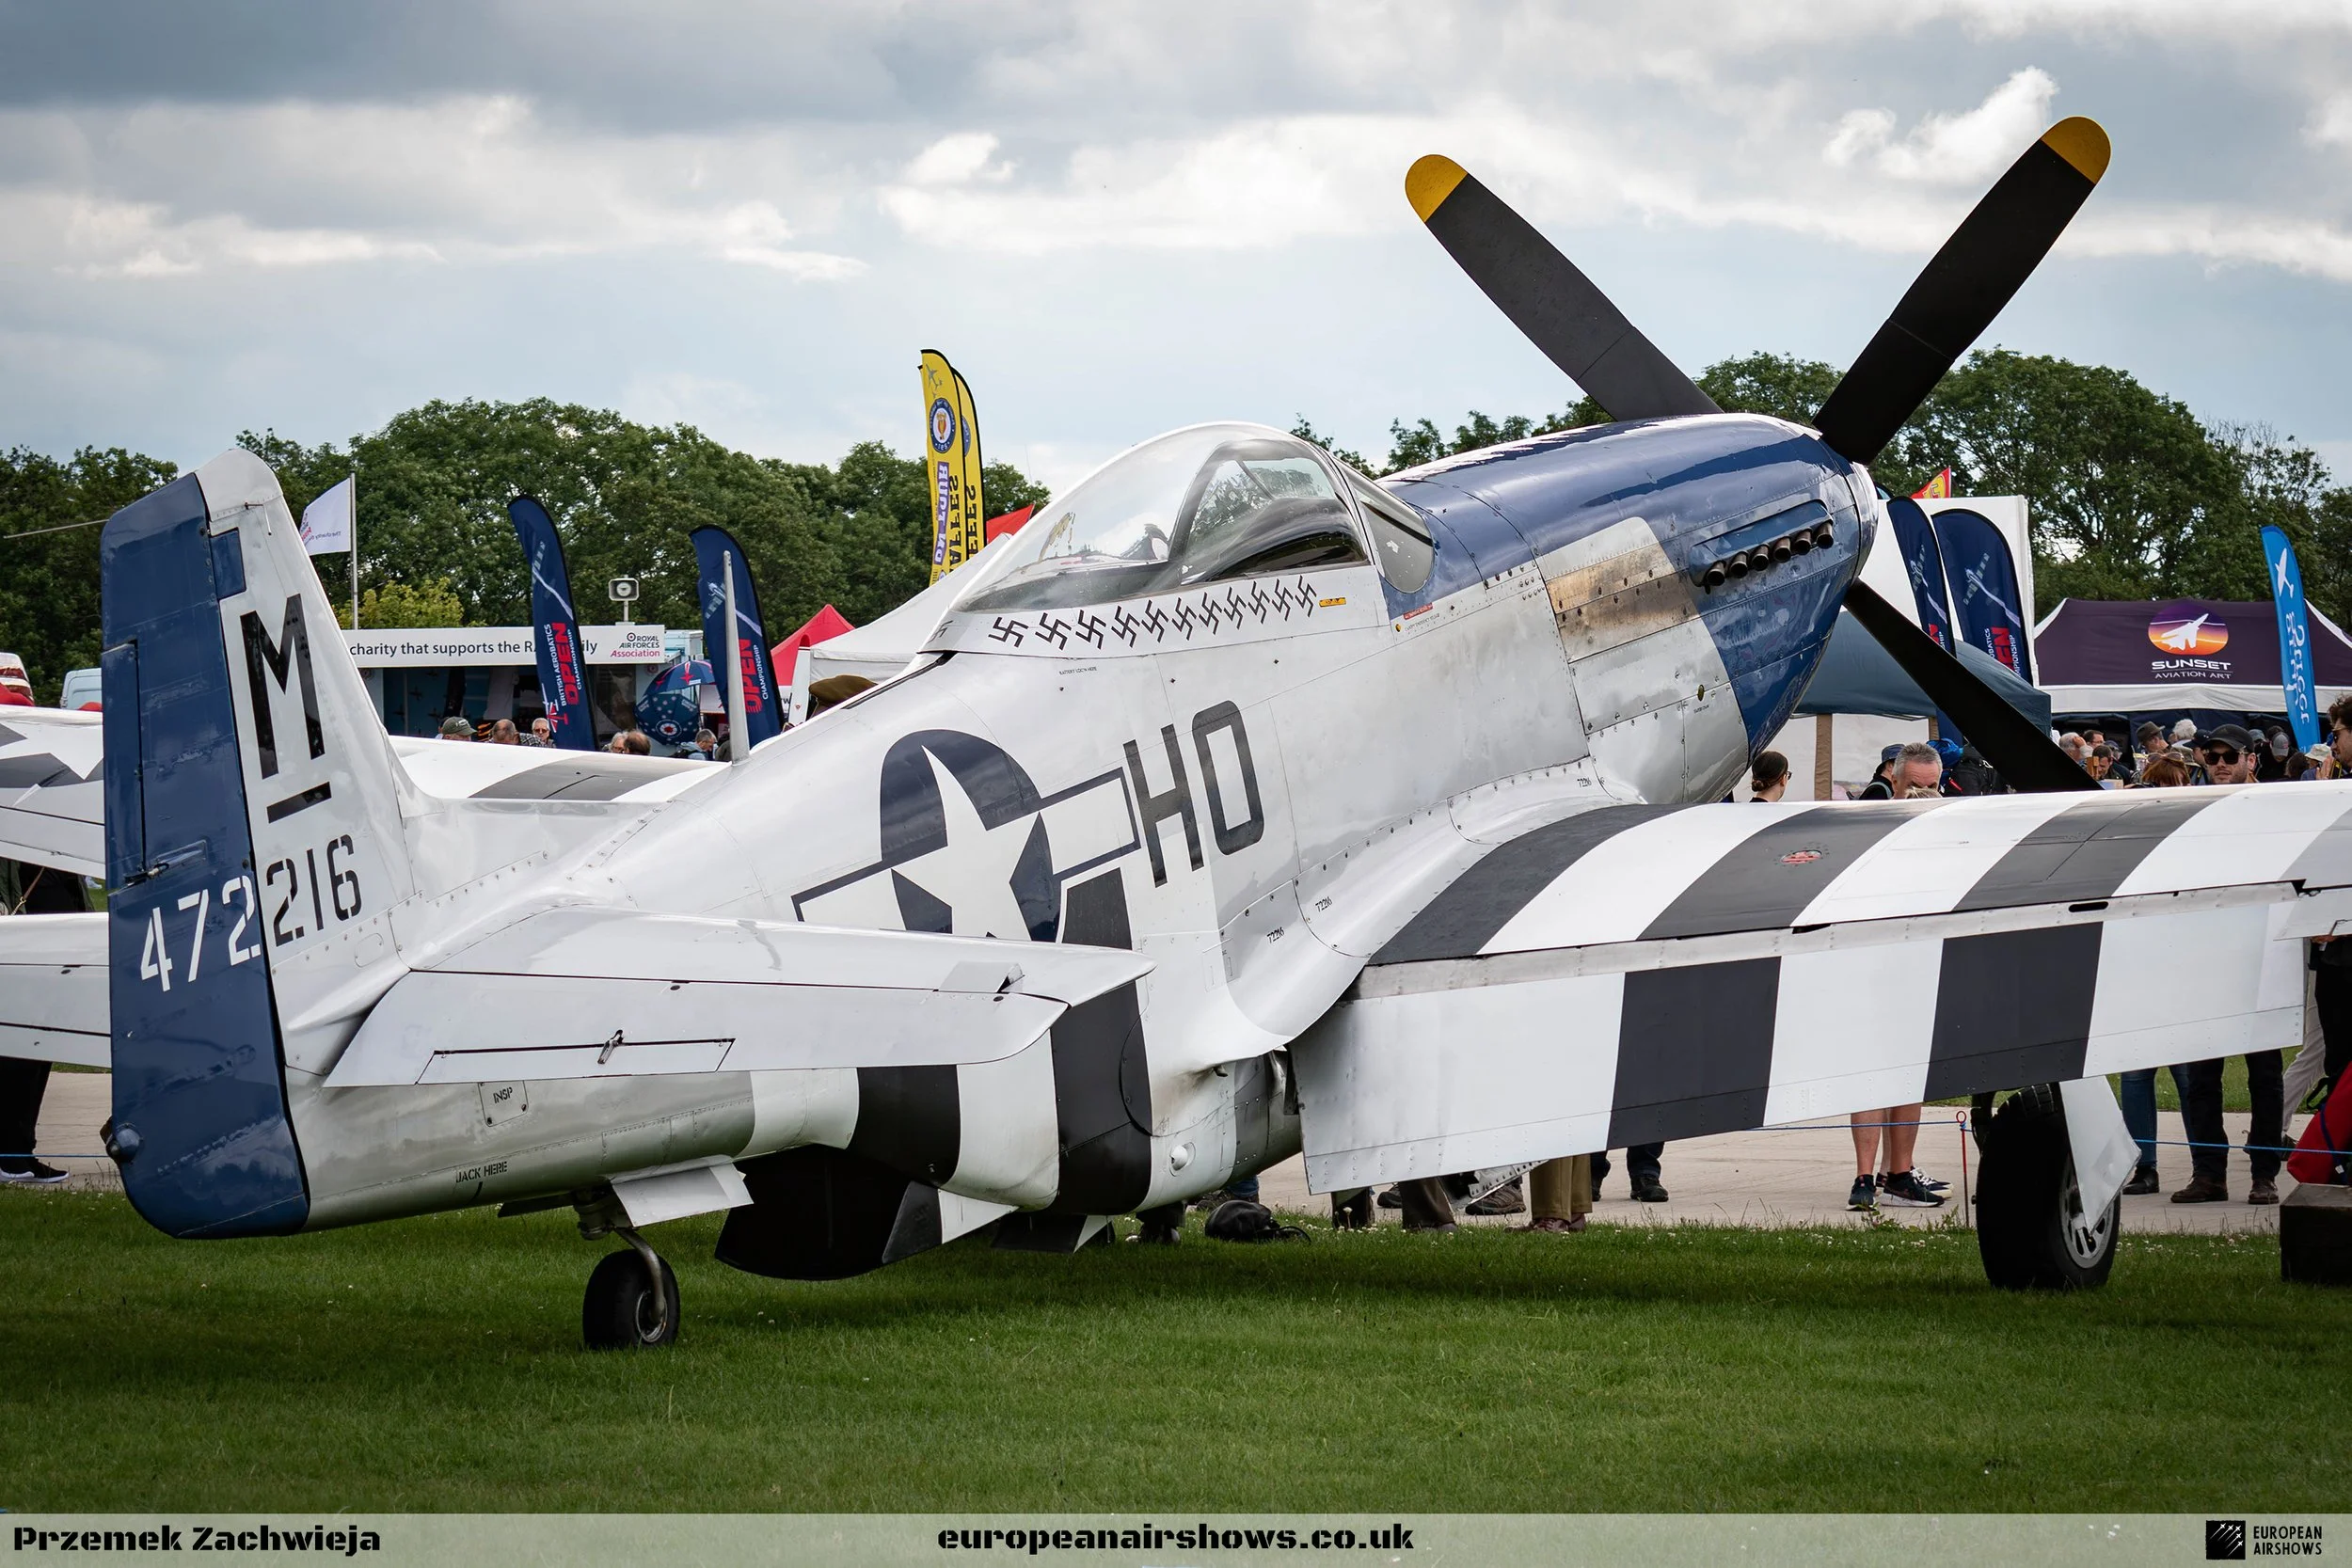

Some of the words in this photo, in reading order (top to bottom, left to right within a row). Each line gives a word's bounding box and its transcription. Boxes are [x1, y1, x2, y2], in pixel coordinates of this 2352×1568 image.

[349, 642, 398, 658] charity
[401, 642, 430, 655] that
[433, 641, 494, 657] supports
[498, 641, 521, 654] the
[524, 641, 536, 653] R
[544, 624, 561, 674] AEROBATICS
[610, 649, 660, 657] Association
[1984, 627, 1995, 658] OBATICS
[551, 623, 580, 705] OPEN
[567, 628, 582, 690] CHAMPIONSHIP
[754, 644, 769, 700] CHAMPIONSHIP
[2152, 658, 2232, 671] SUNSET
[241, 594, 326, 780] M
[555, 674, 567, 706] BRITISH
[2154, 671, 2206, 679] AVIATION
[1122, 700, 1264, 889] HO
[493, 1086, 513, 1104] INSP
[455, 1166, 481, 1183] JACK
[484, 1161, 508, 1177] HERE
